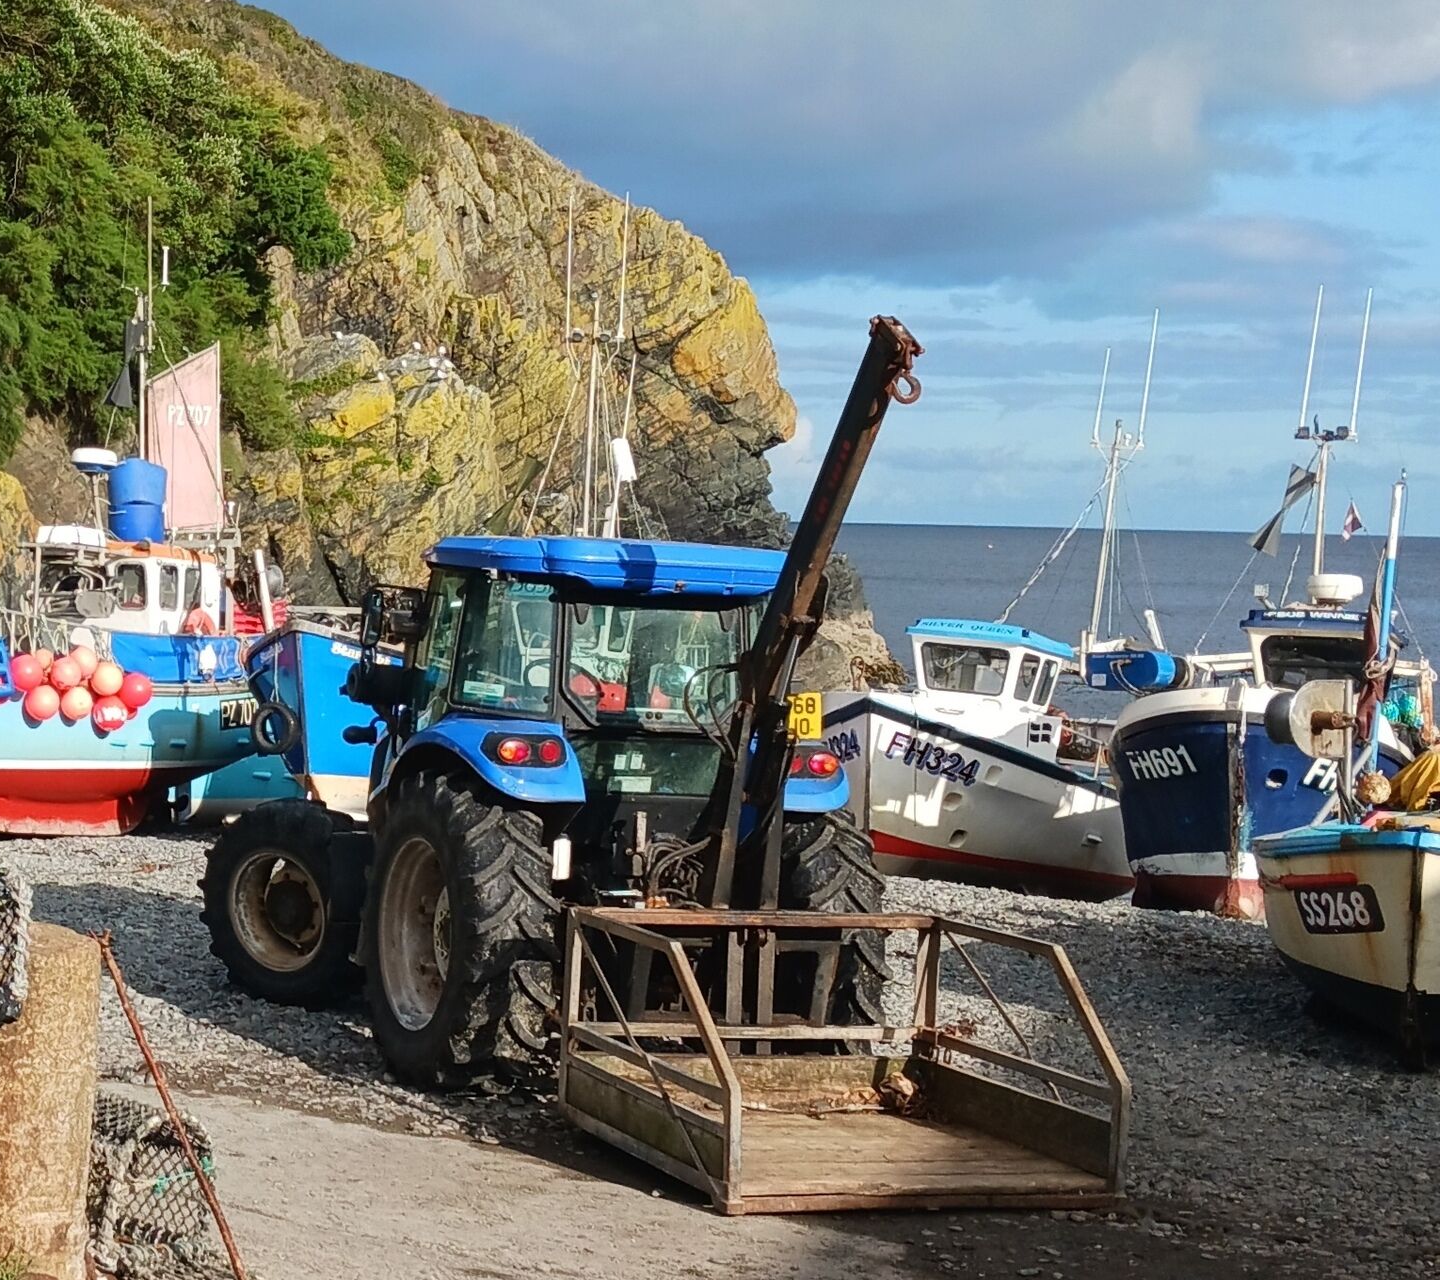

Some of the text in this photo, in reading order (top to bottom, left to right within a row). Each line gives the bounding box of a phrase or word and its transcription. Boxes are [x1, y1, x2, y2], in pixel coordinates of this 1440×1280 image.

[167, 404, 212, 427] PZ 707
[221, 699, 237, 727] PZ
[885, 731, 980, 786] FH324
[1125, 744, 1198, 780] FH691
[1300, 890, 1371, 926] SS268
